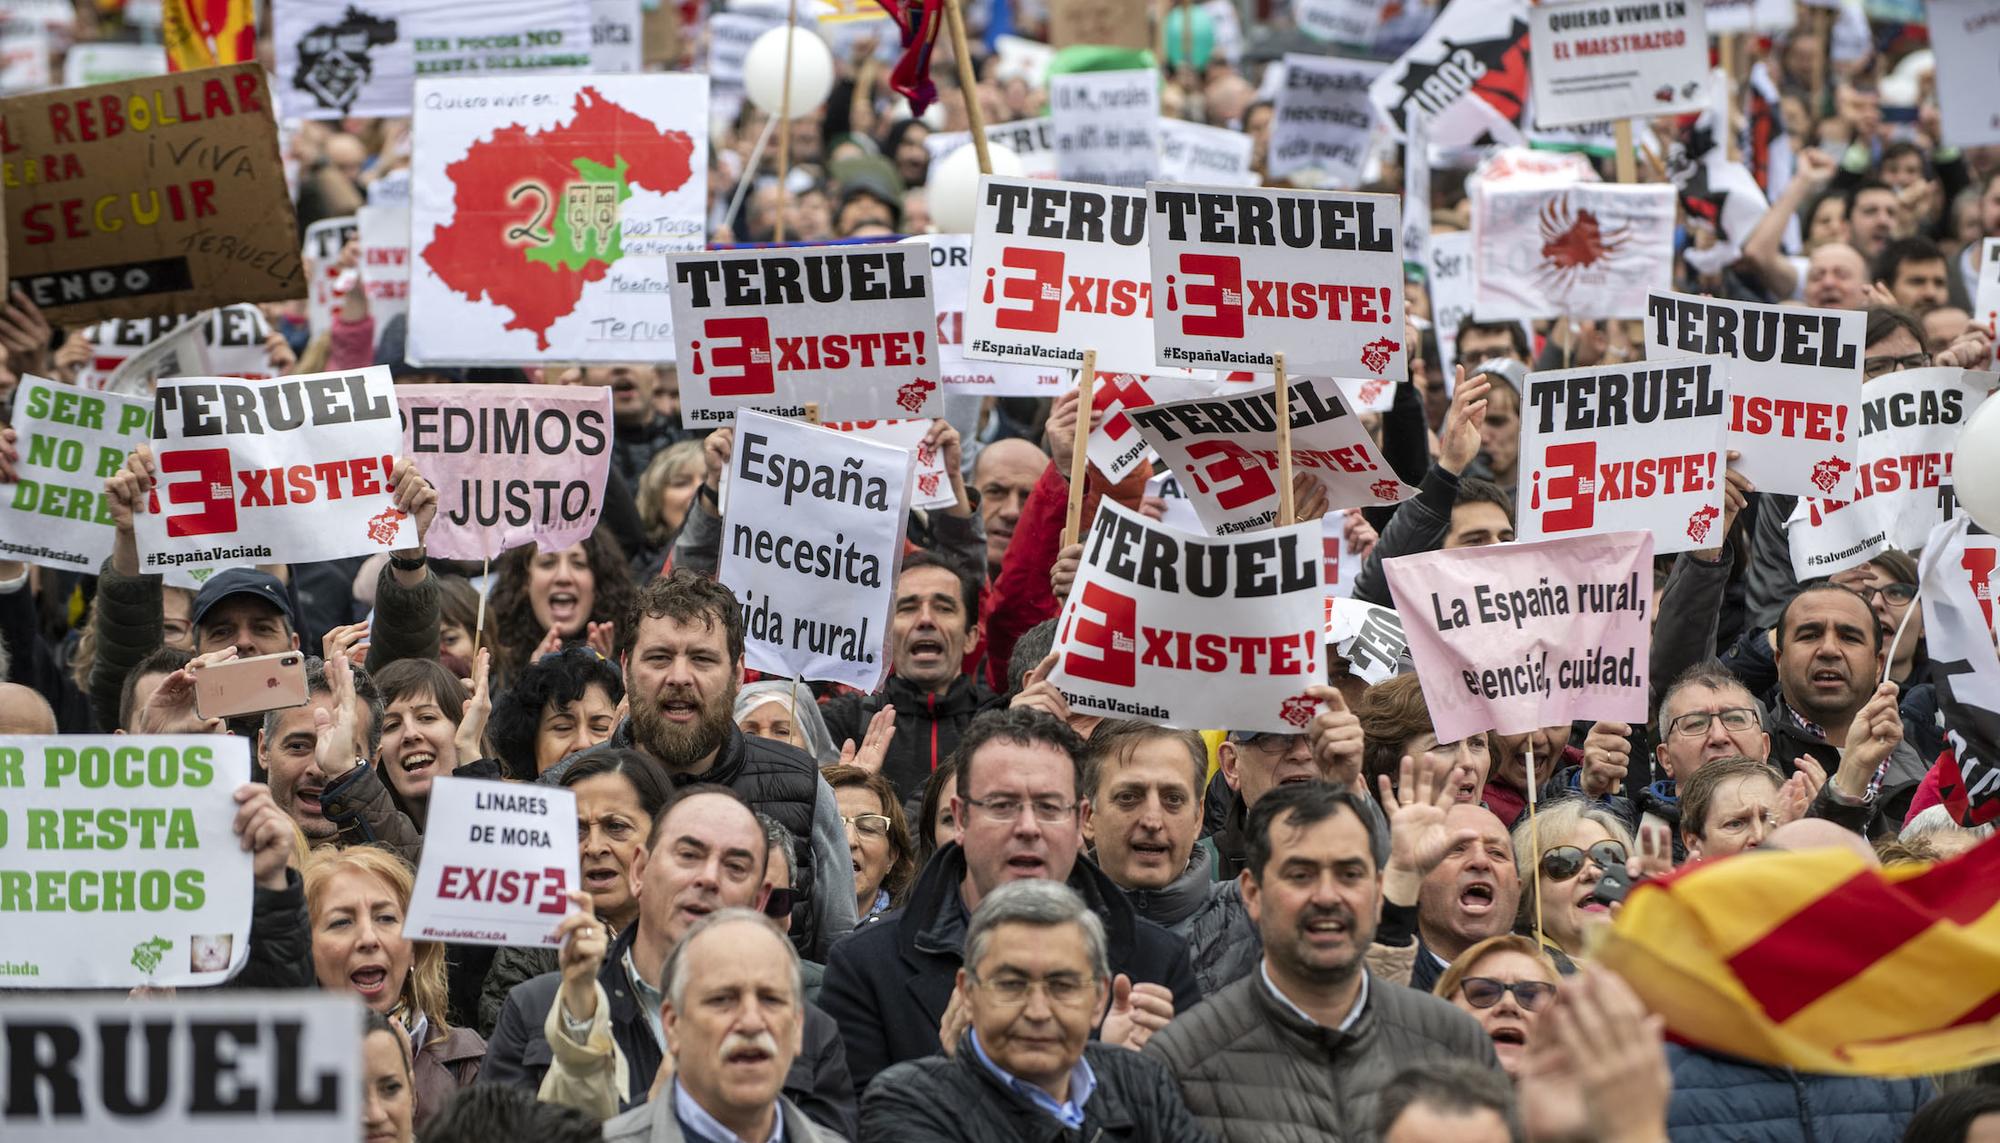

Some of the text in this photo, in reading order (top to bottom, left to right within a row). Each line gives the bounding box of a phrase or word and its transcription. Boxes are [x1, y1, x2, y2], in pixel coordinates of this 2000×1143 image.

[526, 30, 563, 46] NO
[1549, 0, 1687, 32] QUIERO VIVIR EN
[1553, 29, 1687, 61] EL MAESTRAZGO
[47, 73, 263, 146] REBOLLAR
[424, 91, 488, 111] Quiero
[3, 154, 86, 188] ERRA
[22, 179, 218, 246] SEGUIR
[986, 183, 1147, 247] TERU
[1156, 190, 1395, 253] TERUEL
[677, 252, 927, 308] TERUEL
[590, 316, 672, 341] Terue
[972, 339, 1084, 362] #EspañaVaciada
[1648, 293, 1857, 370] TERUEL
[1163, 345, 1274, 367] #EspañaVaciada
[26, 385, 106, 431] SER
[152, 374, 392, 440] TERUEL
[1131, 380, 1348, 443] TERUEL
[1530, 364, 1725, 434] TERUEL
[1728, 394, 1849, 443] ISTE!
[1859, 388, 1965, 437] NCAS
[27, 433, 84, 473] NO
[739, 431, 889, 512] España
[449, 479, 597, 528] JUSTO.
[0, 538, 89, 565] spañaVaciada
[146, 544, 273, 567] #EspañaVaciada
[732, 522, 882, 589] necesita
[1088, 505, 1318, 599] TERUEL
[1807, 530, 1887, 567] #SalvemosTeruel
[1431, 571, 1646, 632] La España rural,
[791, 616, 875, 665] rural.
[44, 745, 215, 789] POCOS
[475, 791, 549, 816] LINARES
[26, 807, 200, 850] RESTA
[469, 823, 552, 849] DE MORA
[0, 868, 207, 913] RECHOS
[0, 1017, 340, 1118] RUEL
